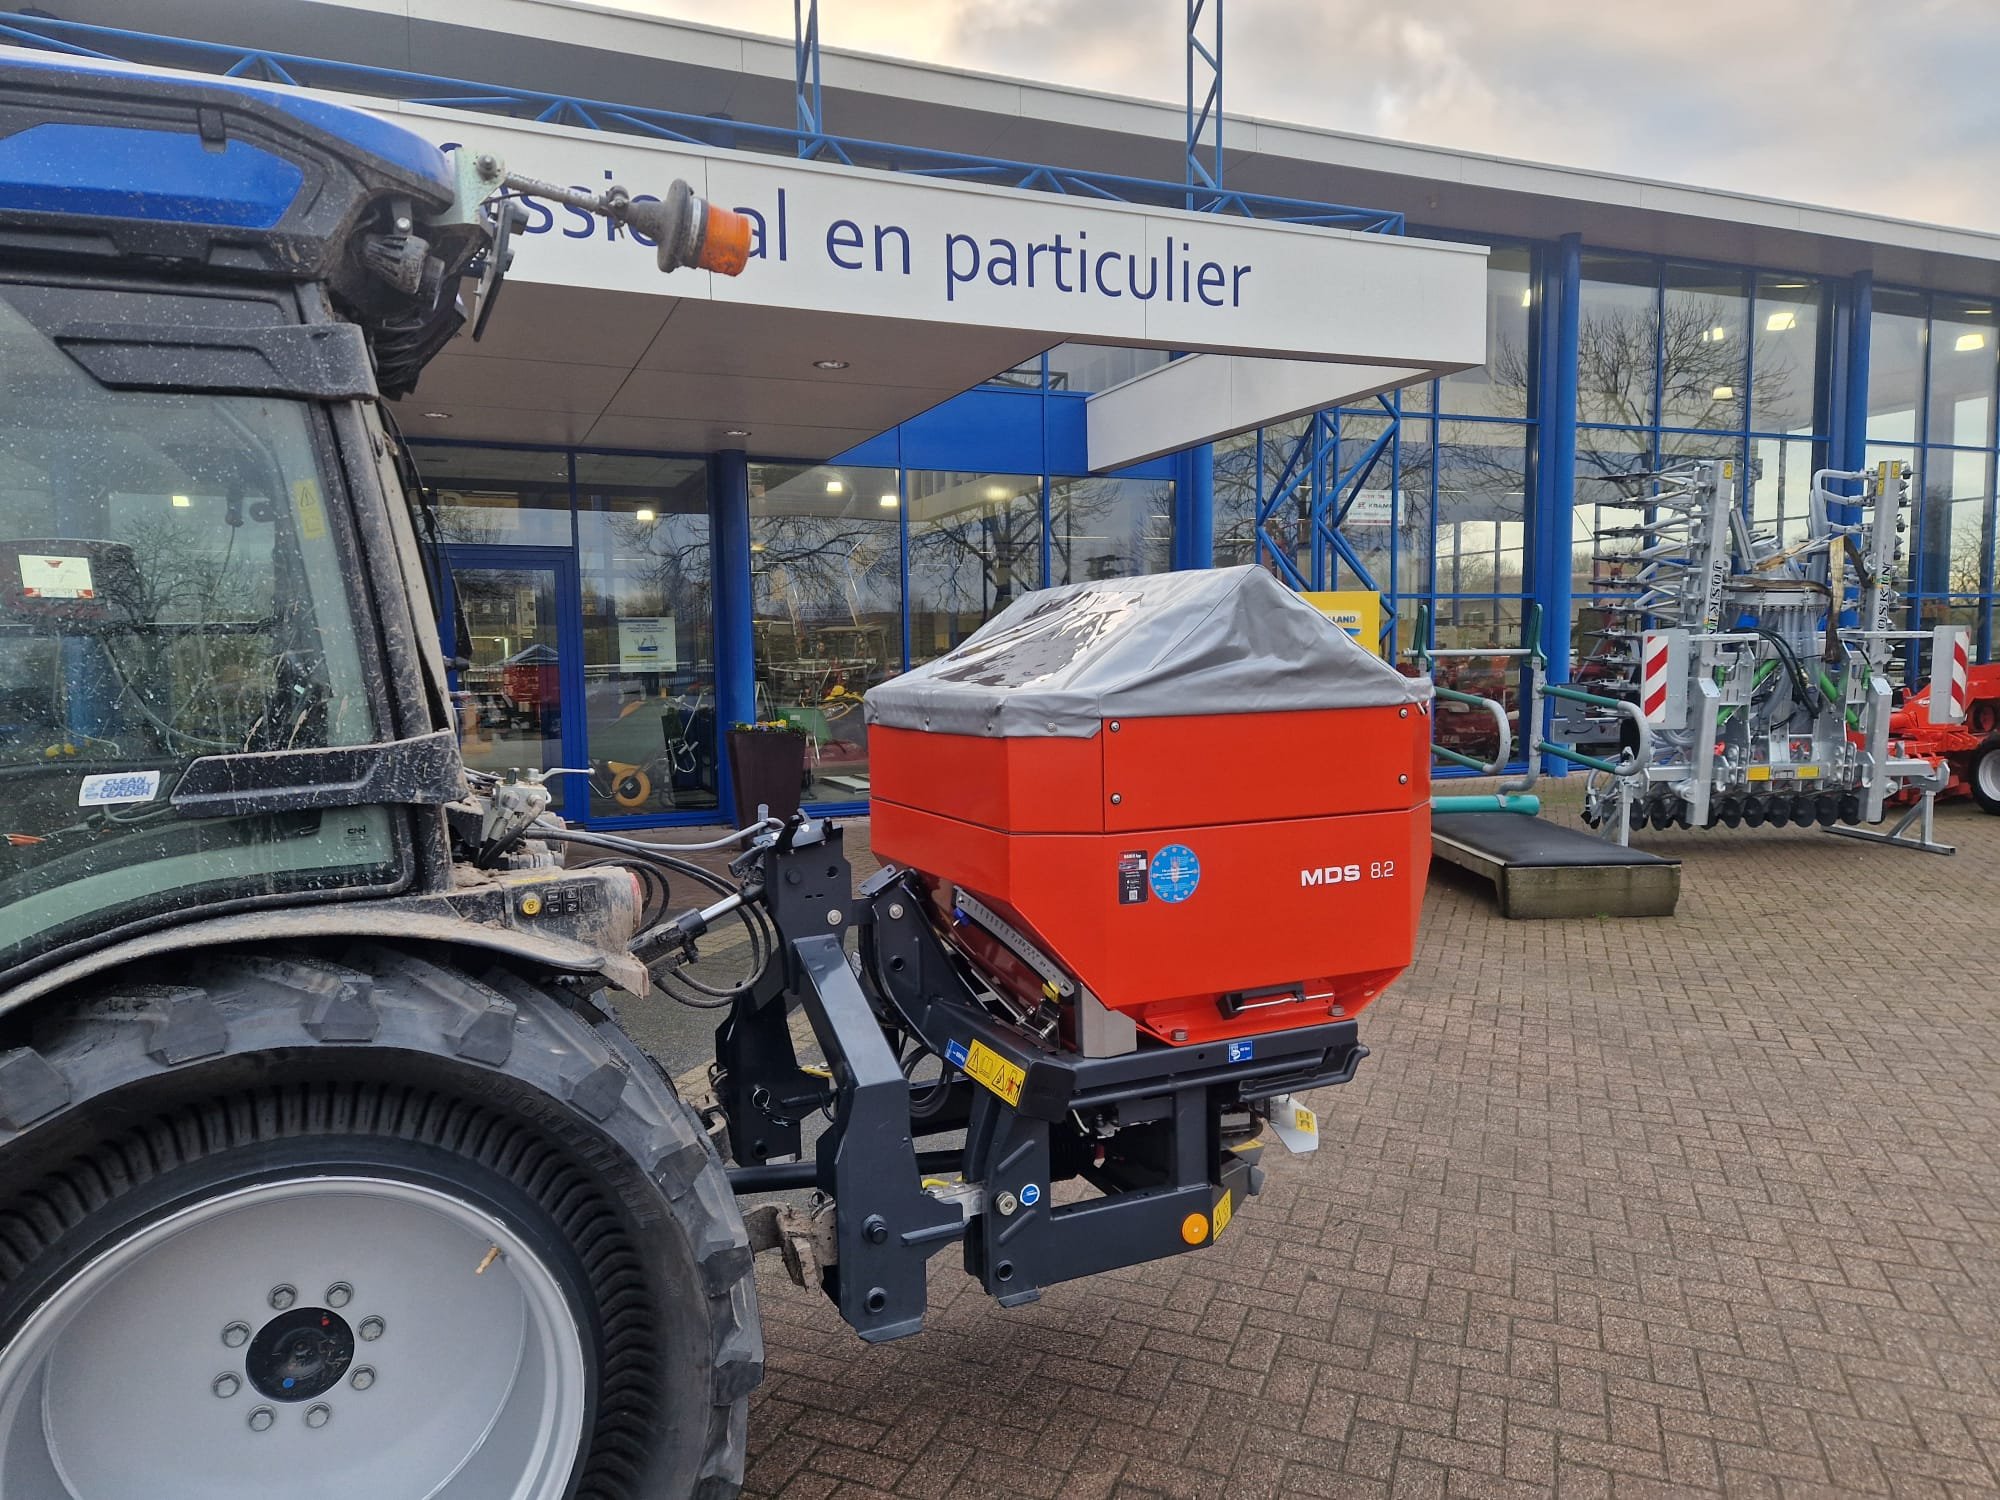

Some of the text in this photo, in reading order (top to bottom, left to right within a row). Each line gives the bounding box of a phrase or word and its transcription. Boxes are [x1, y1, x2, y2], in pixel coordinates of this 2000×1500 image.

[826, 219, 911, 275] en
[946, 231, 1252, 307] particulier
[1877, 561, 1892, 632] OSKIN
[1328, 615, 1356, 623] LAND
[105, 776, 147, 785] CLEAN
[102, 782, 154, 792] ENERGY
[100, 789, 149, 798] LEADER
[1301, 860, 1394, 887] MDS 8.2
